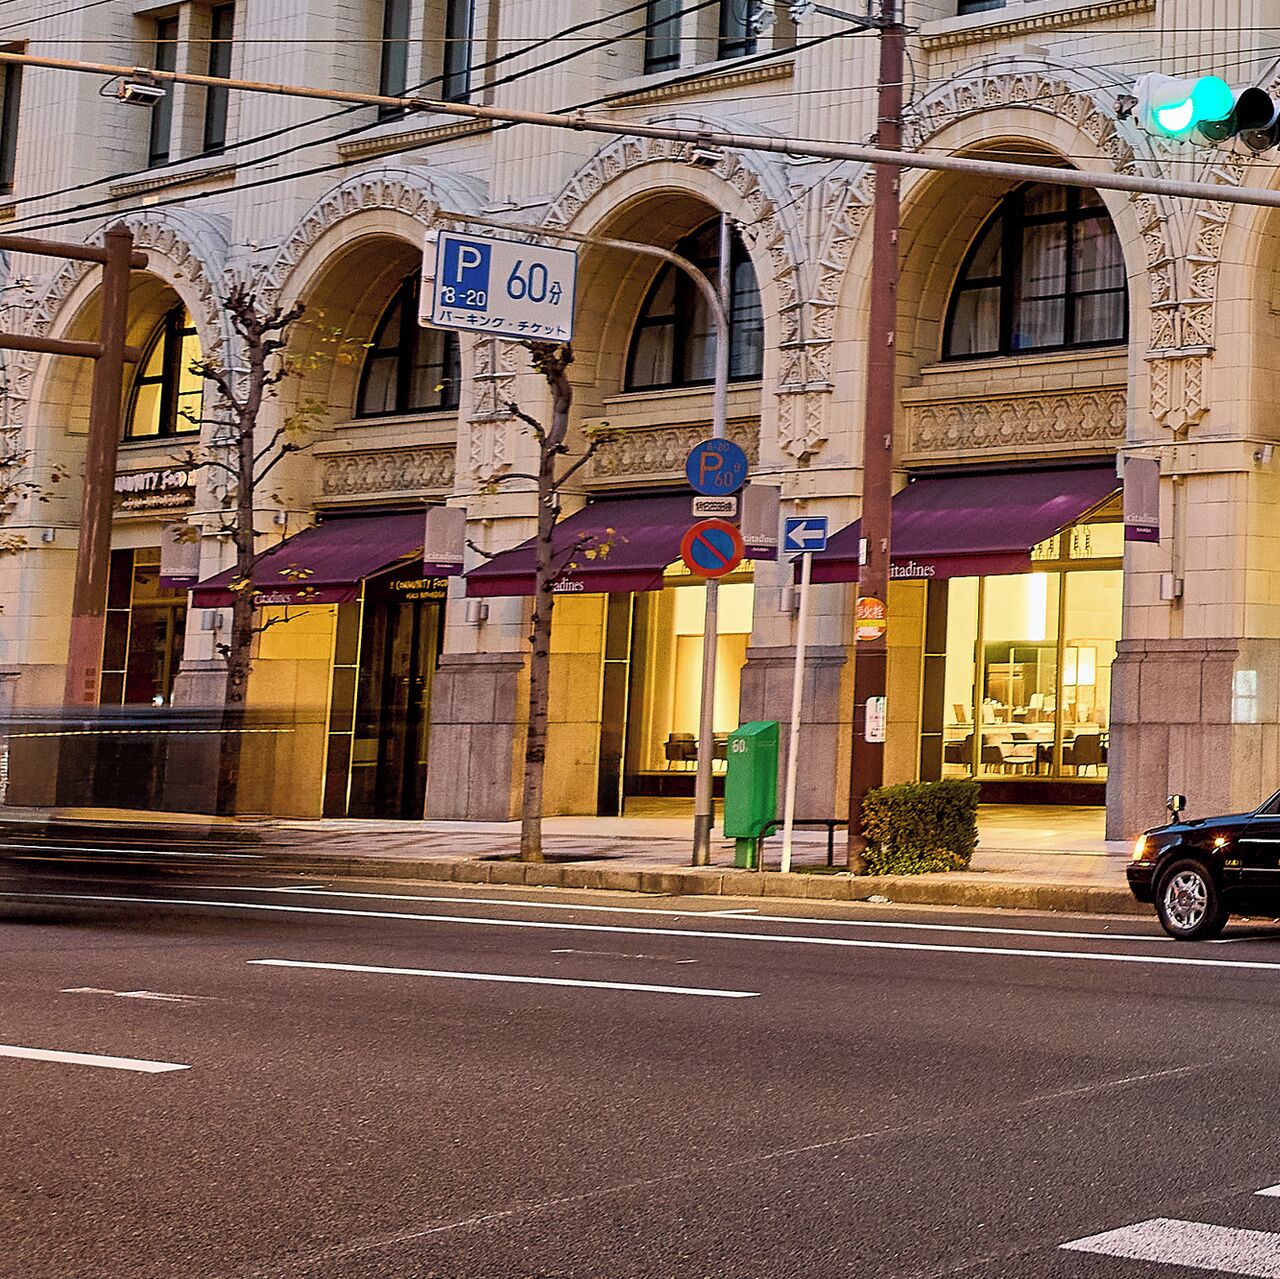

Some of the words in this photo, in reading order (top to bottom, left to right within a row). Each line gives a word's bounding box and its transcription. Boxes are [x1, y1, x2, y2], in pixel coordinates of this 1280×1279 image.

[456, 245, 482, 283] P
[507, 259, 562, 305] 60分
[440, 310, 567, 336] パーキング・チケット
[700, 451, 724, 486] P
[552, 576, 584, 592] adines
[889, 560, 936, 578] itadines
